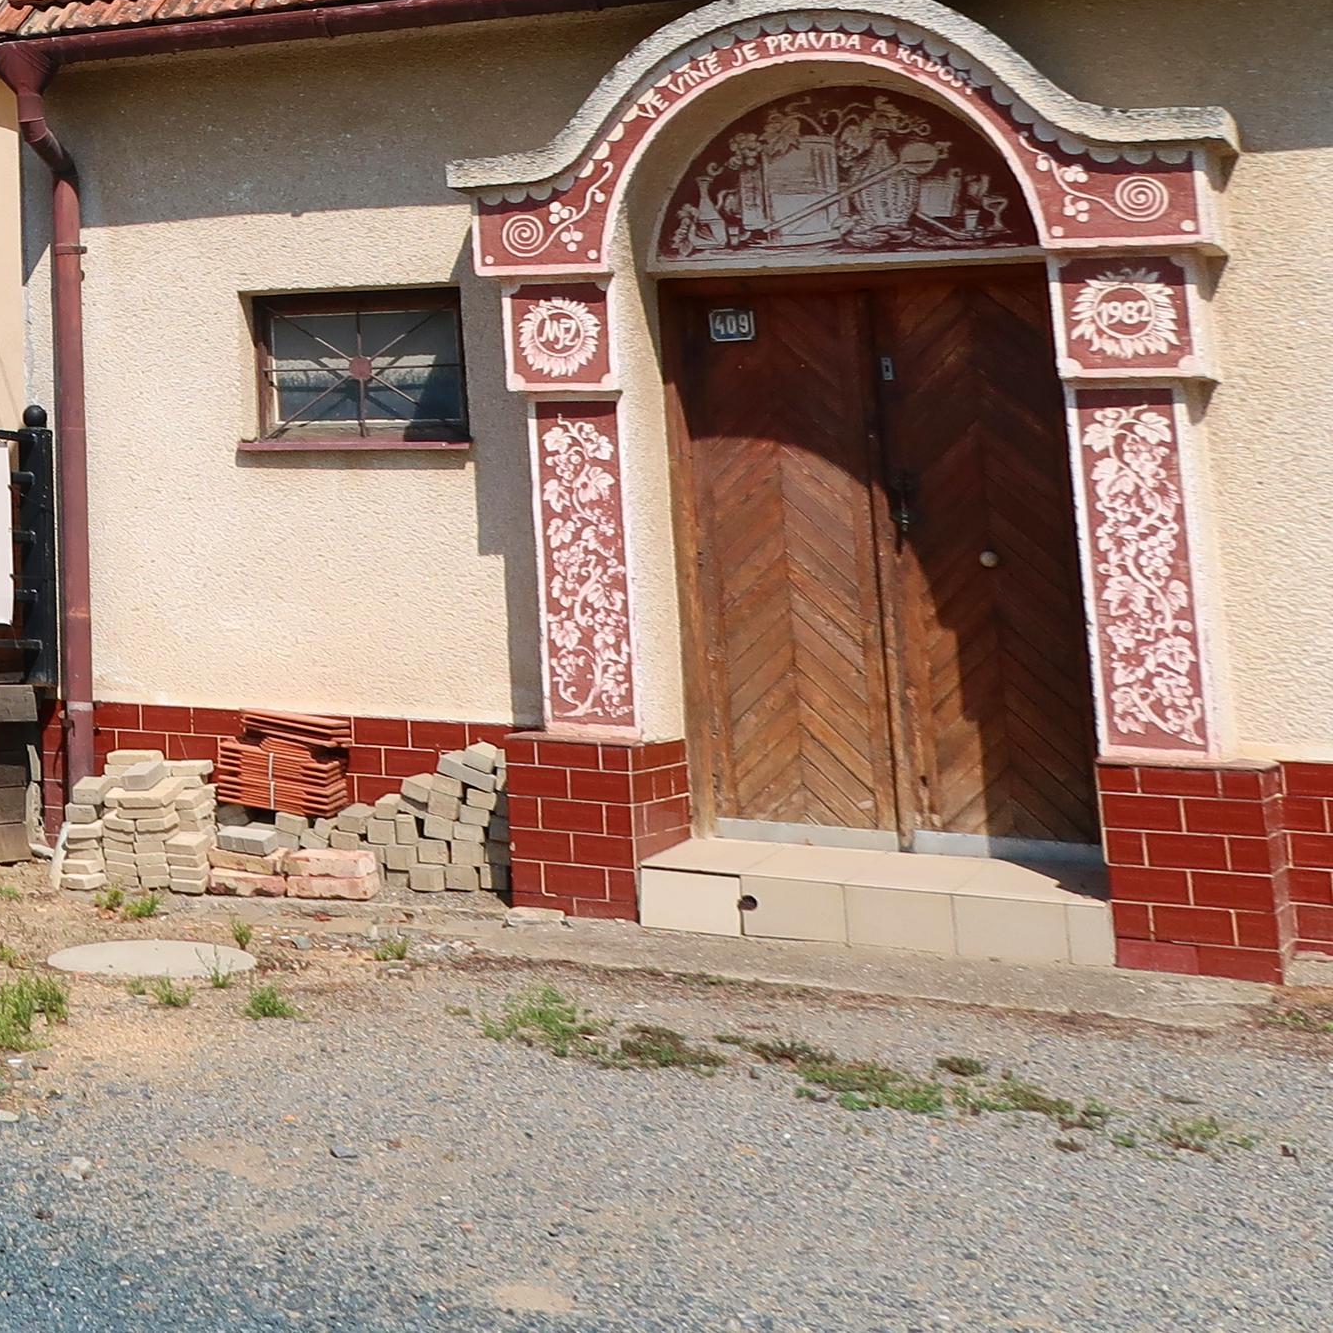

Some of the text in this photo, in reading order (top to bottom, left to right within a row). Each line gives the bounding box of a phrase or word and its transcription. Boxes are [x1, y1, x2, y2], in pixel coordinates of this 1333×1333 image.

[637, 94, 670, 119] VE
[731, 42, 760, 67] JE
[763, 32, 861, 55] PRAVDA
[871, 39, 889, 55] A
[715, 314, 749, 334] 409
[1097, 300, 1152, 326] 1982
